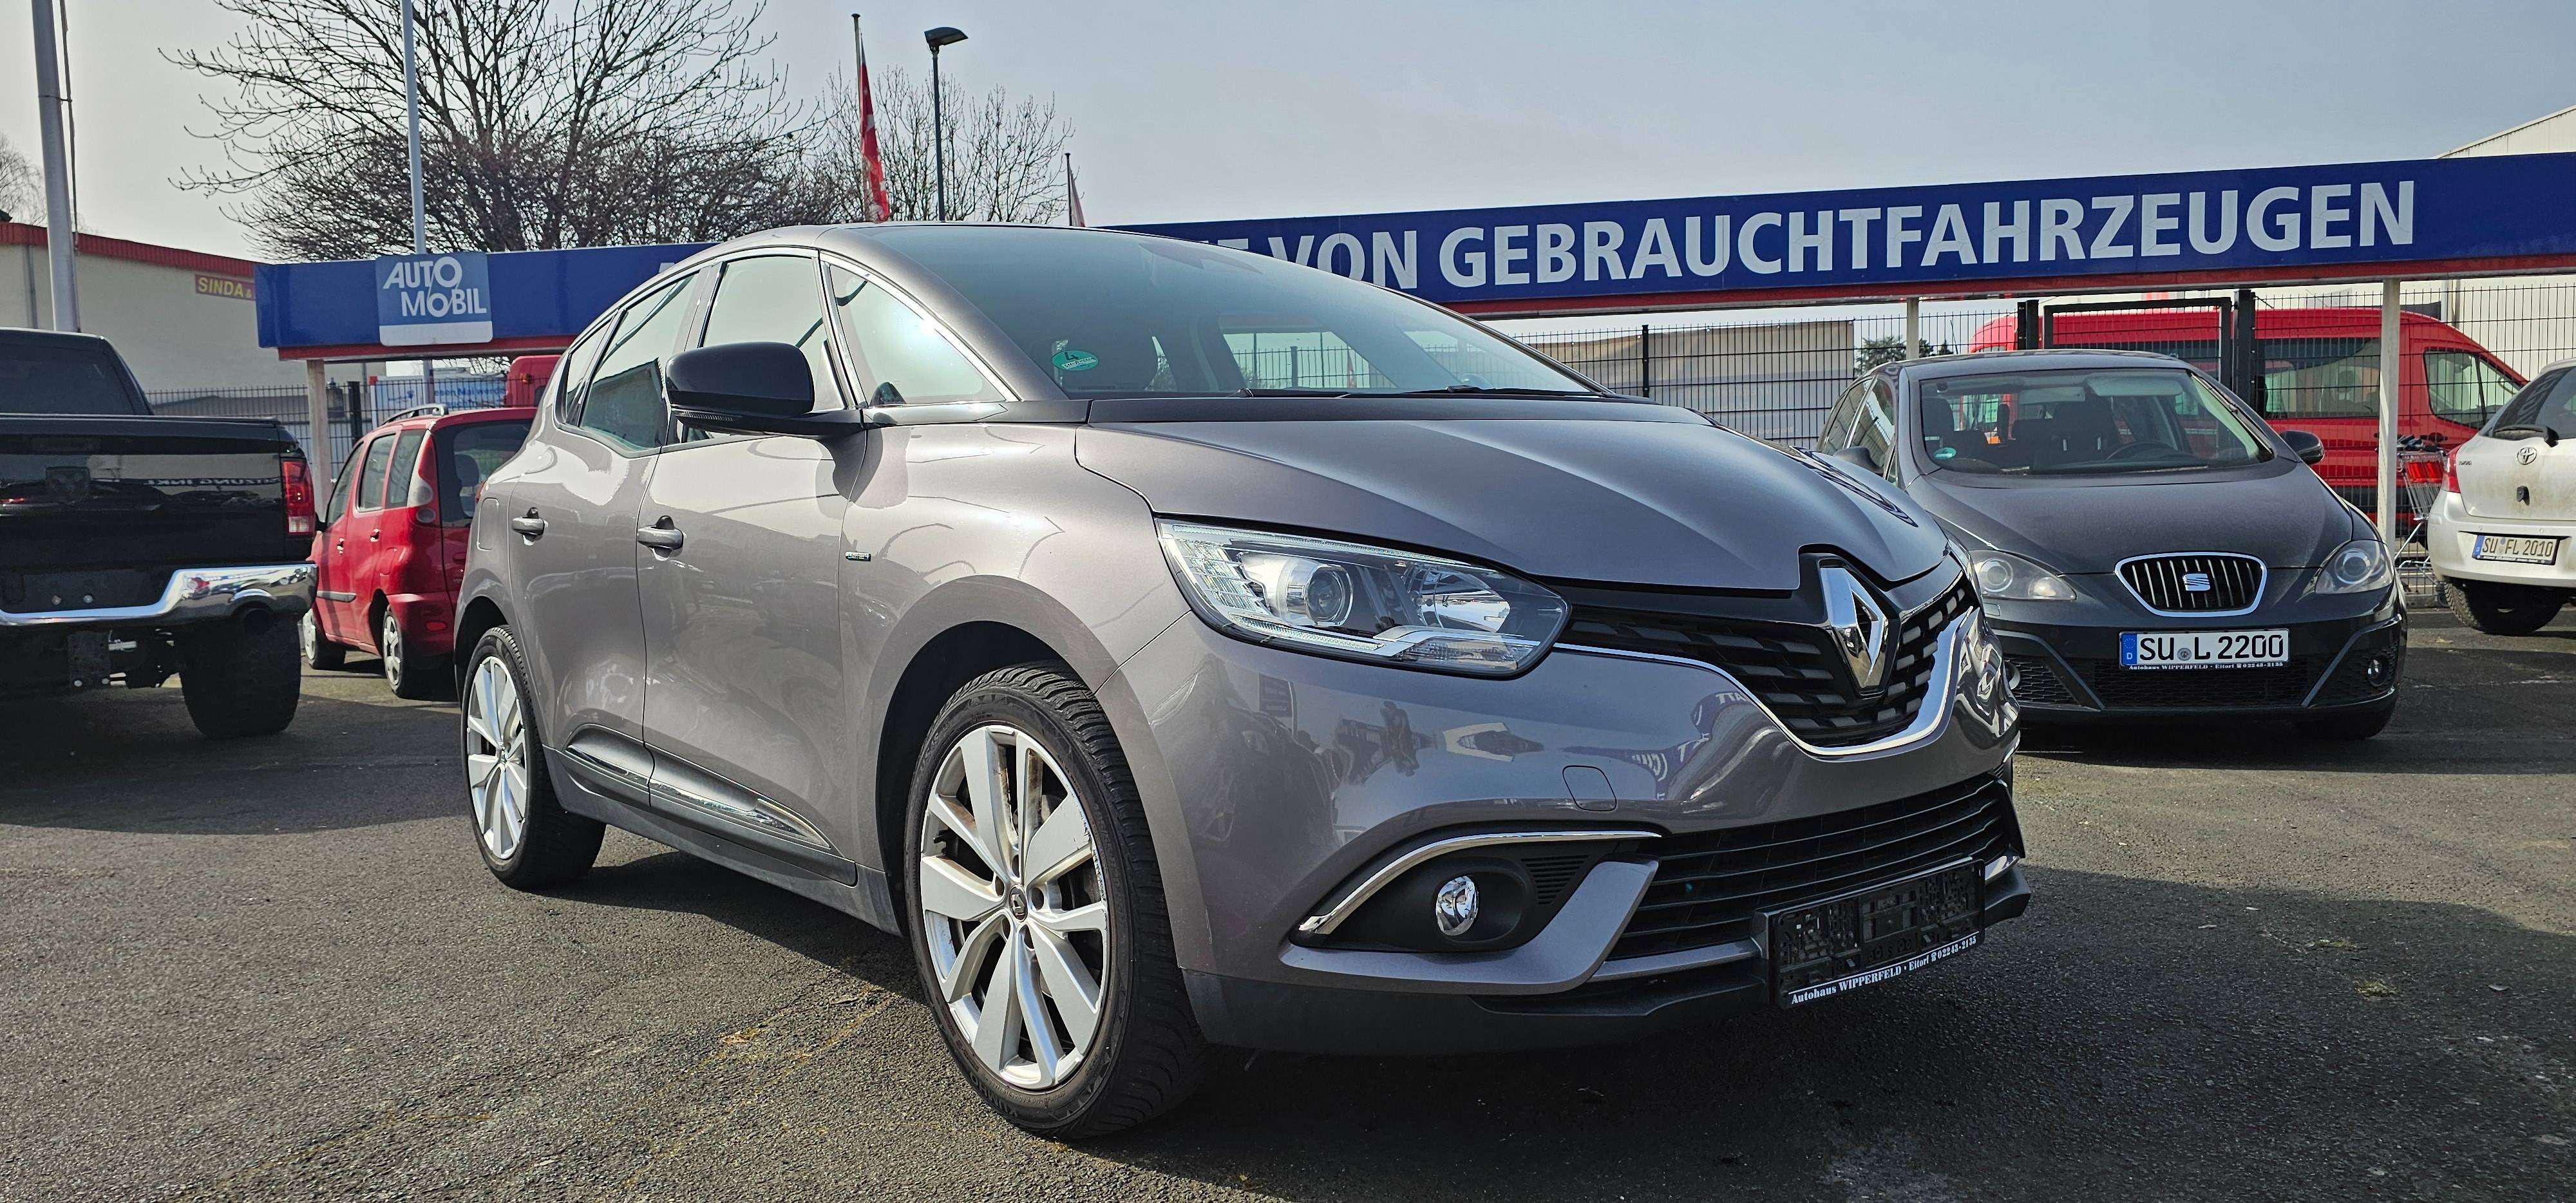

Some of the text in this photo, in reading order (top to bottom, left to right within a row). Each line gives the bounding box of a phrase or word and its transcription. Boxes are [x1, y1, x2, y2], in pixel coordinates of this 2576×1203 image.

[1439, 180, 2414, 288] GEBRAUCHTFAHRZEUGEN
[383, 256, 462, 289] AUTO
[198, 277, 243, 298] SINDA
[401, 288, 487, 317] MOBIL
[2482, 538, 2553, 557] SU FL 2010
[2139, 634, 2284, 661] SU L 2200
[1791, 935, 1977, 1005] Autohaus WIPPERFELD Eitorf 02243-2135
